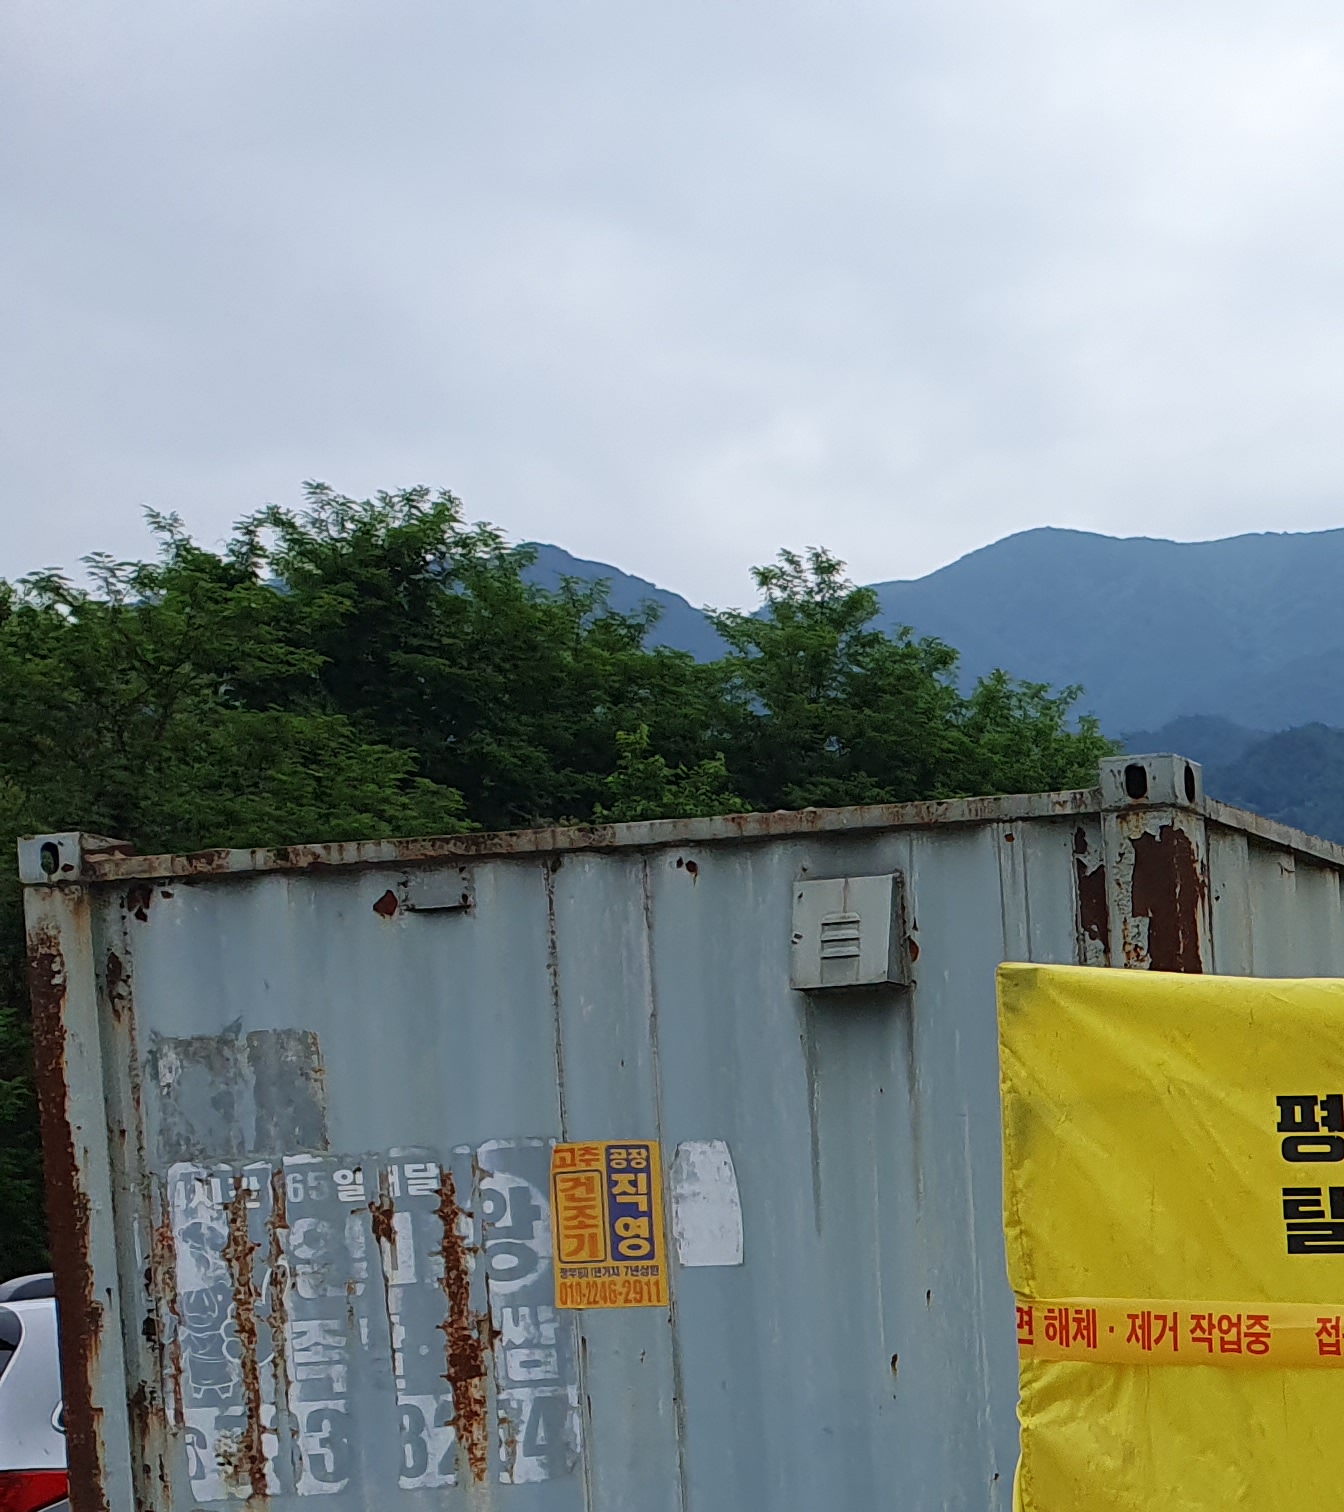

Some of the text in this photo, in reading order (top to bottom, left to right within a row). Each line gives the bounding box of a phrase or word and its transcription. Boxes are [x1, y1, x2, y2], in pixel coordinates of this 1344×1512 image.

[552, 1146, 599, 1168] 고추
[609, 1148, 647, 1168] 공장
[610, 1172, 650, 1256] 직영
[1044, 1308, 1097, 1349] 해체
[1127, 1312, 1178, 1352] 제거
[1190, 1314, 1271, 1355] 작업중
